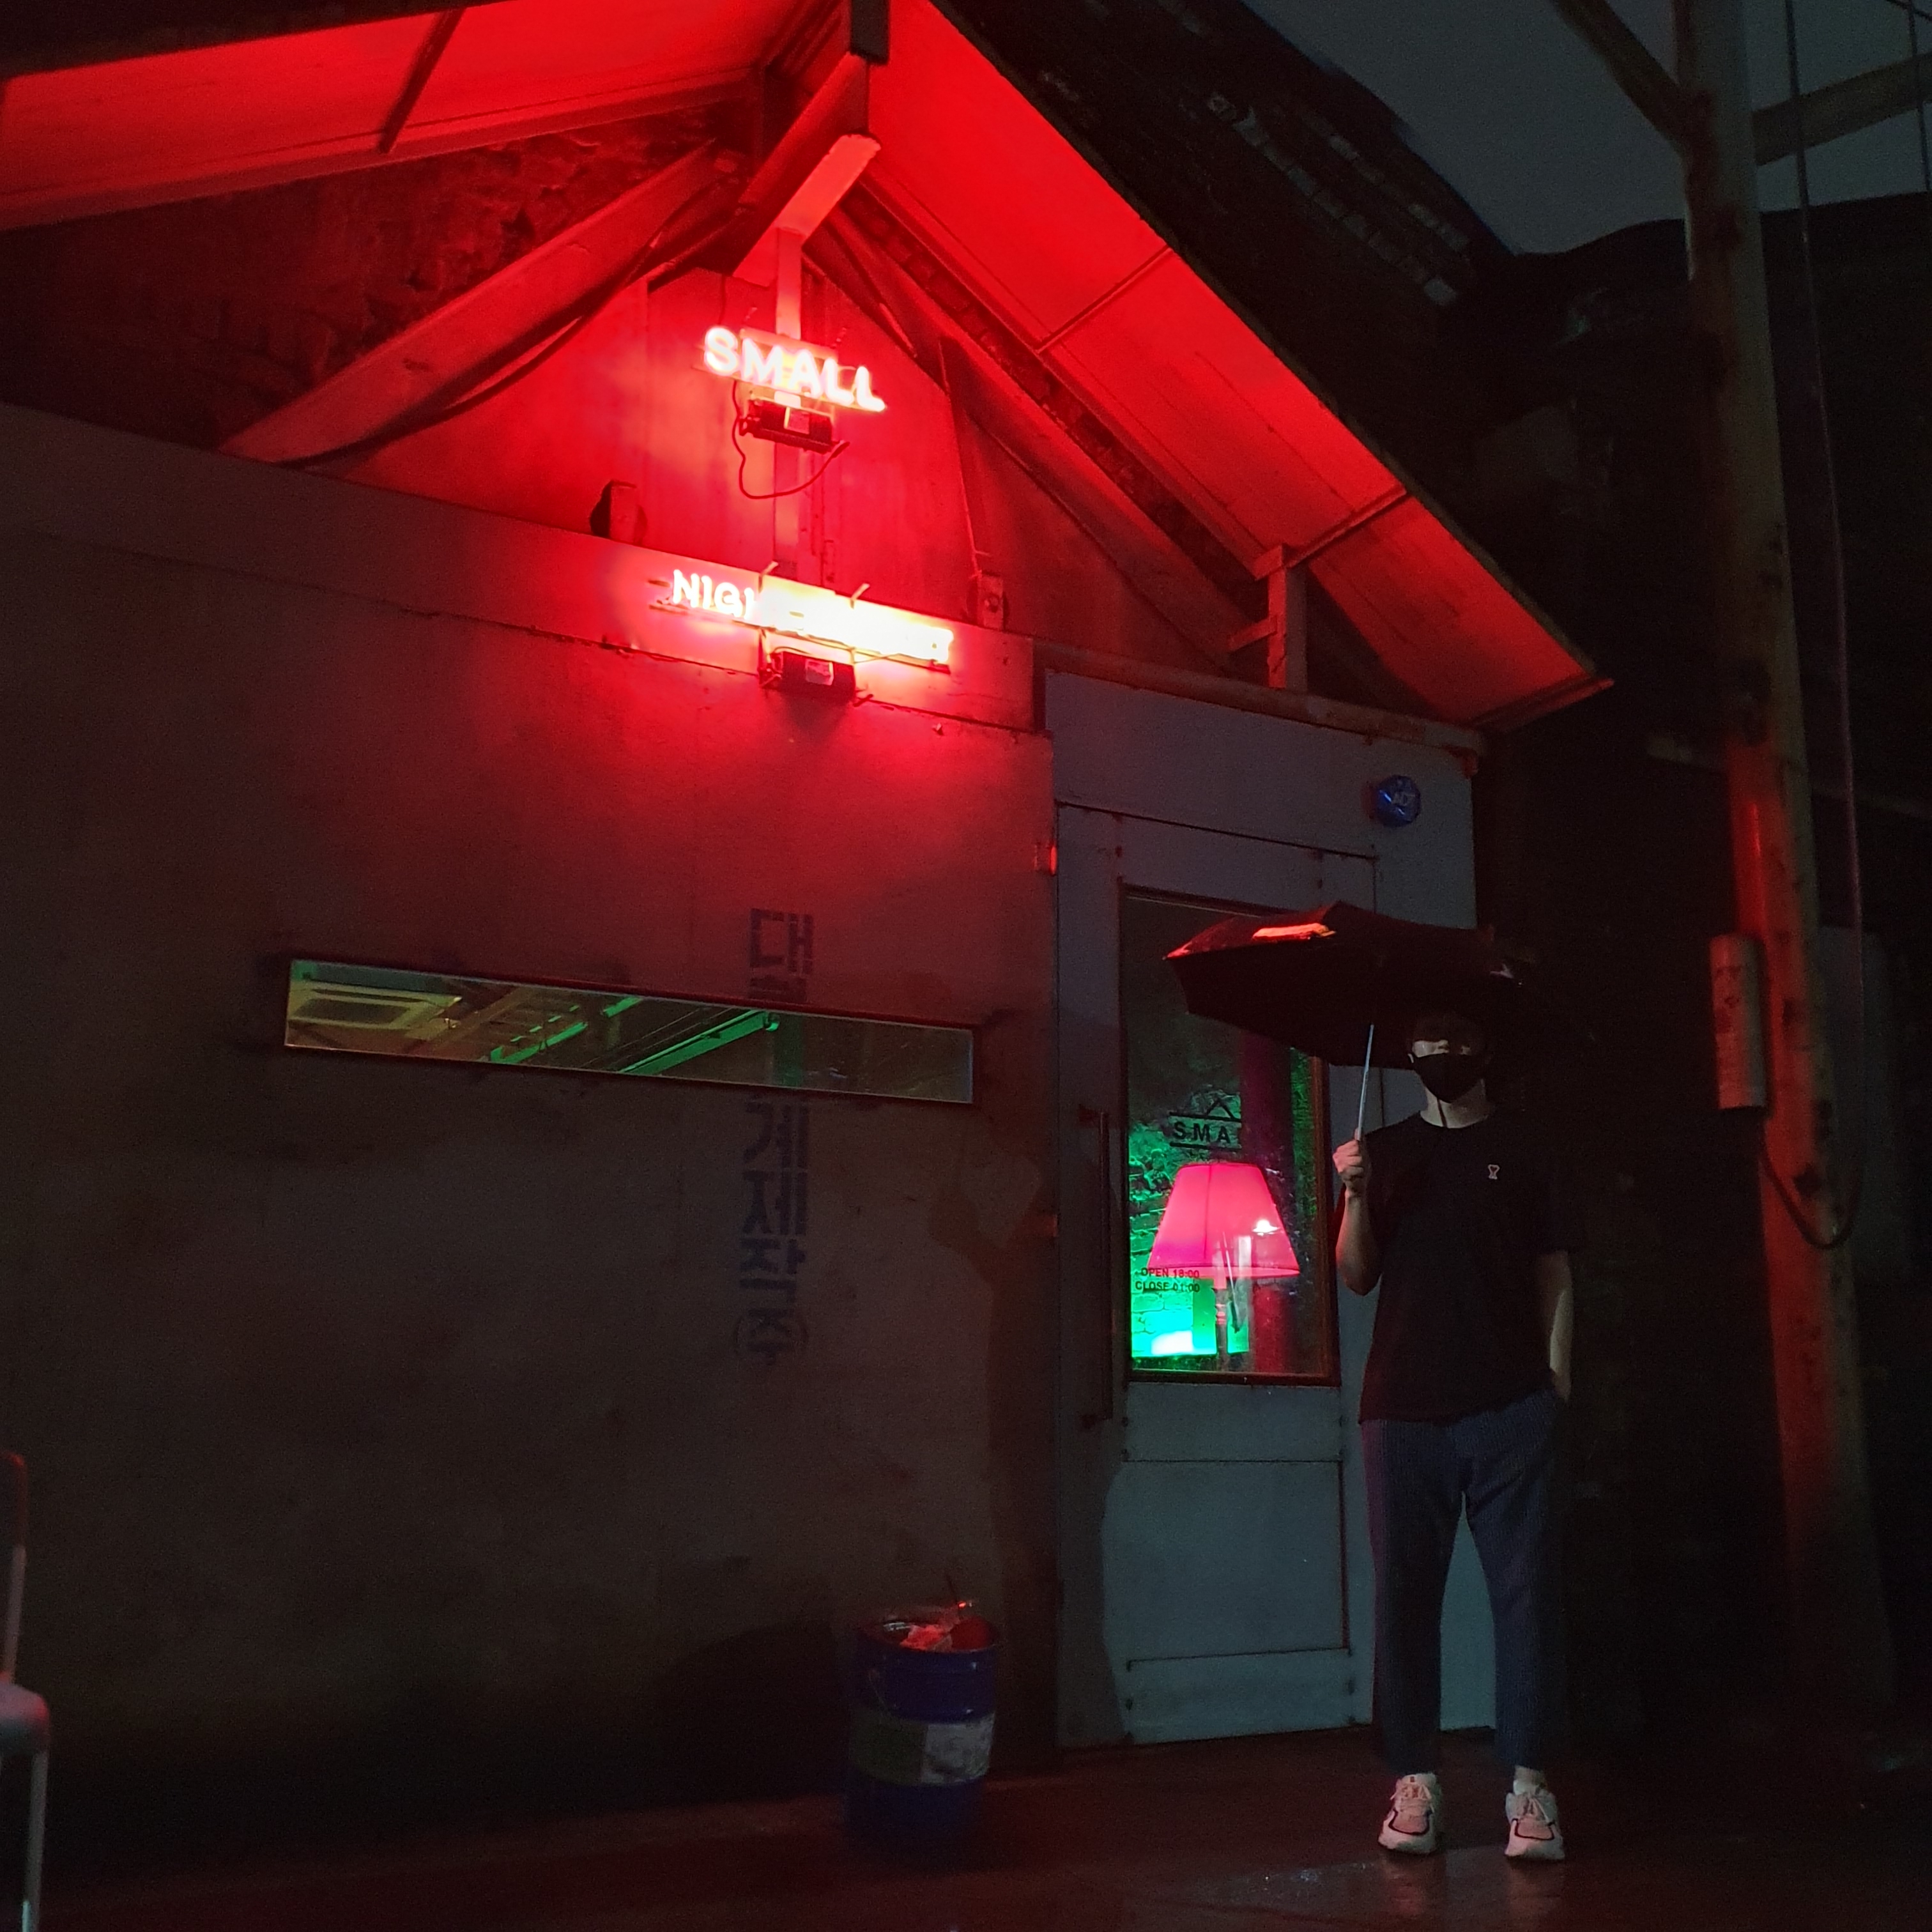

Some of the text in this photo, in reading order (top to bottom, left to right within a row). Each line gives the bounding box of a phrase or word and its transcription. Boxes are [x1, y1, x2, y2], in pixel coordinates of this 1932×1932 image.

[703, 325, 887, 412] SMALL
[1173, 1121, 1240, 1145] SMA
[1141, 1267, 1169, 1278] OPEN
[1135, 1280, 1170, 1292] CLOSE
